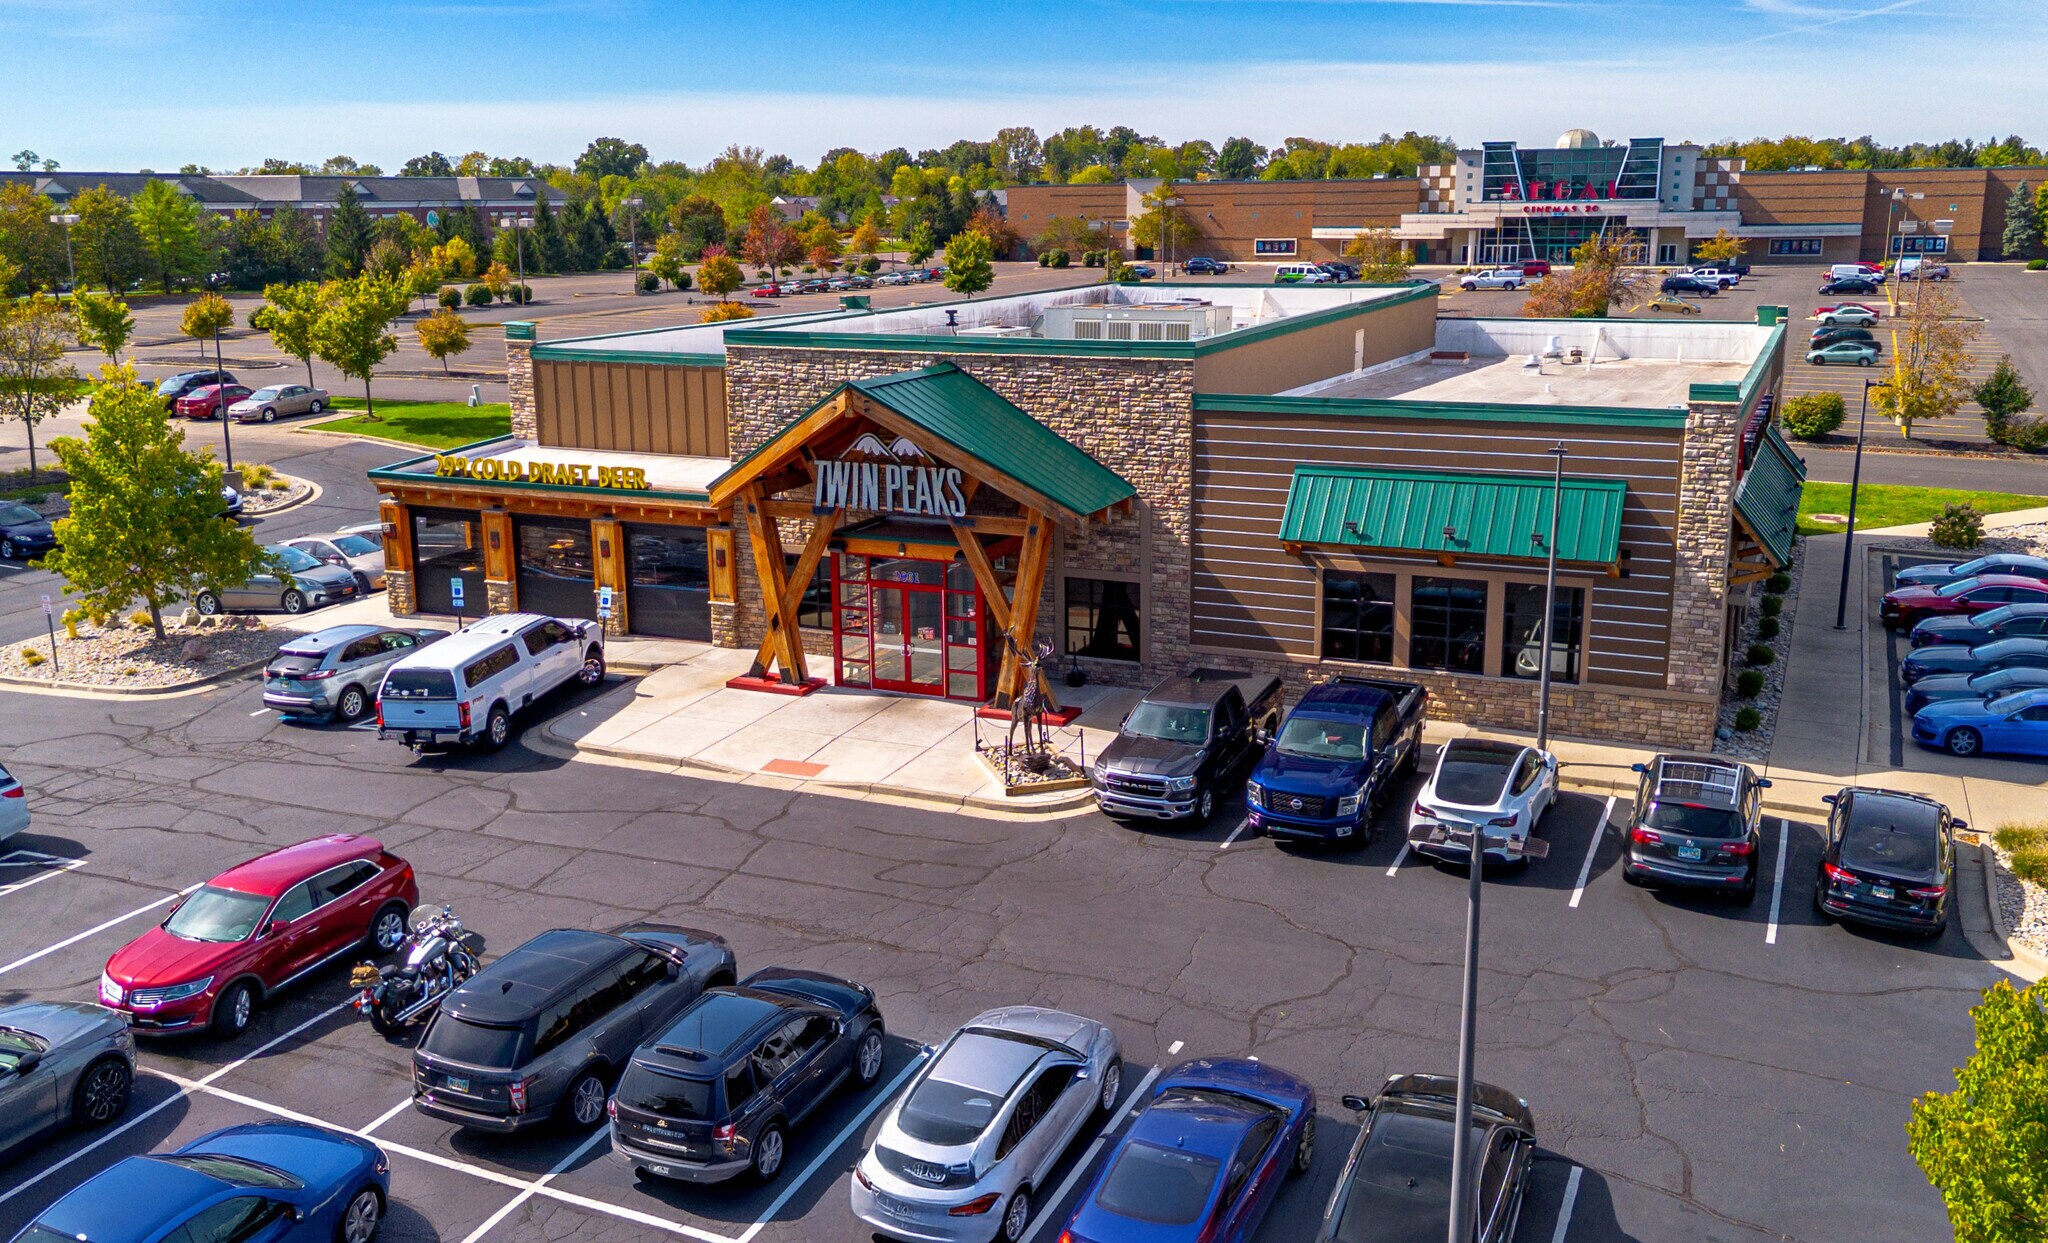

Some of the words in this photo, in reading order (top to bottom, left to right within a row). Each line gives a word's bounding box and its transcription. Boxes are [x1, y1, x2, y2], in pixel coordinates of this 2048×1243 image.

[1503, 179, 1622, 200] REGAL
[1523, 205, 1577, 213] CINEMAS
[471, 457, 522, 481] COLD
[528, 461, 591, 486] DRAFT
[597, 465, 649, 490] BEER
[814, 459, 879, 511] TWIN
[885, 464, 966, 517] PEAKS
[1122, 781, 1147, 789] RAM
